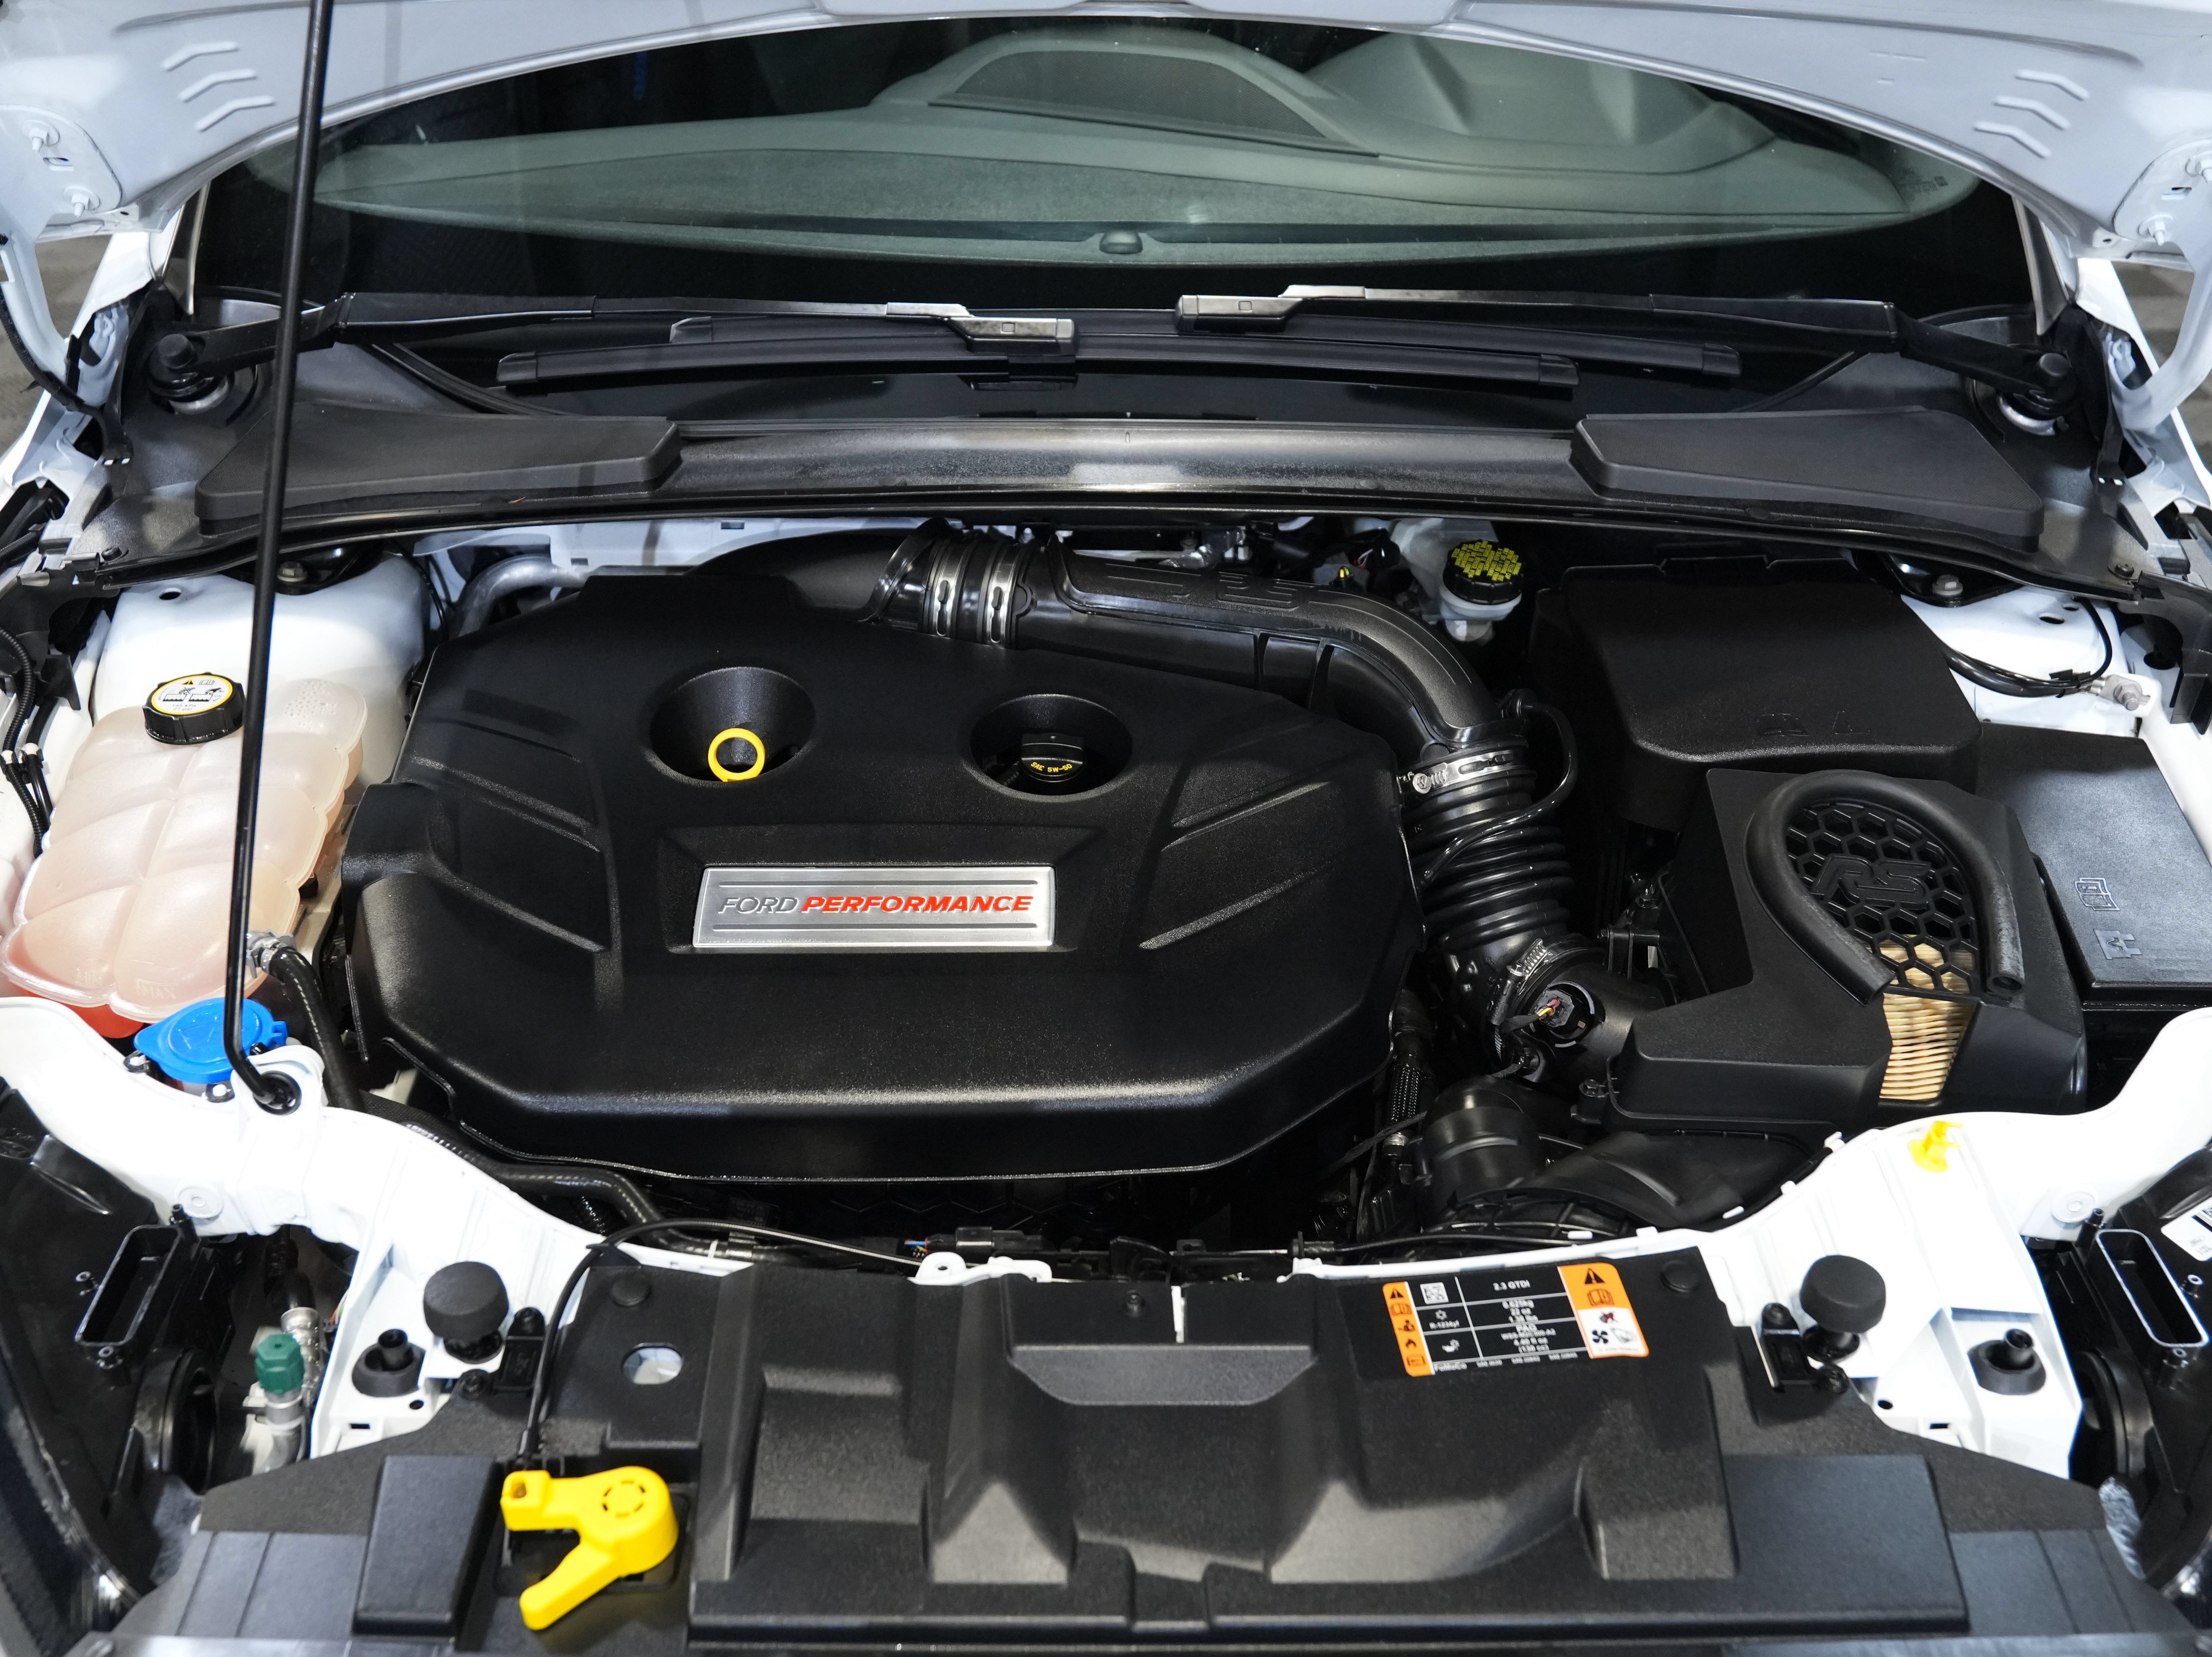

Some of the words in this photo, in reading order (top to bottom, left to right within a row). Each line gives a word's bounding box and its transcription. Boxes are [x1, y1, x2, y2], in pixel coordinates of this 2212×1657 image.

[1030, 762, 1045, 771] SAE
[1047, 763, 1073, 773] 5W-50
[1810, 854, 1932, 910] RS
[718, 897, 800, 914] FORD
[801, 895, 1032, 913] PERFORMANCE
[1493, 1282, 1507, 1291] 2.3
[1508, 1280, 1531, 1289] GTDI
[1516, 1323, 1538, 1333] PAG
[1434, 1362, 1467, 1372] FoMoCo
